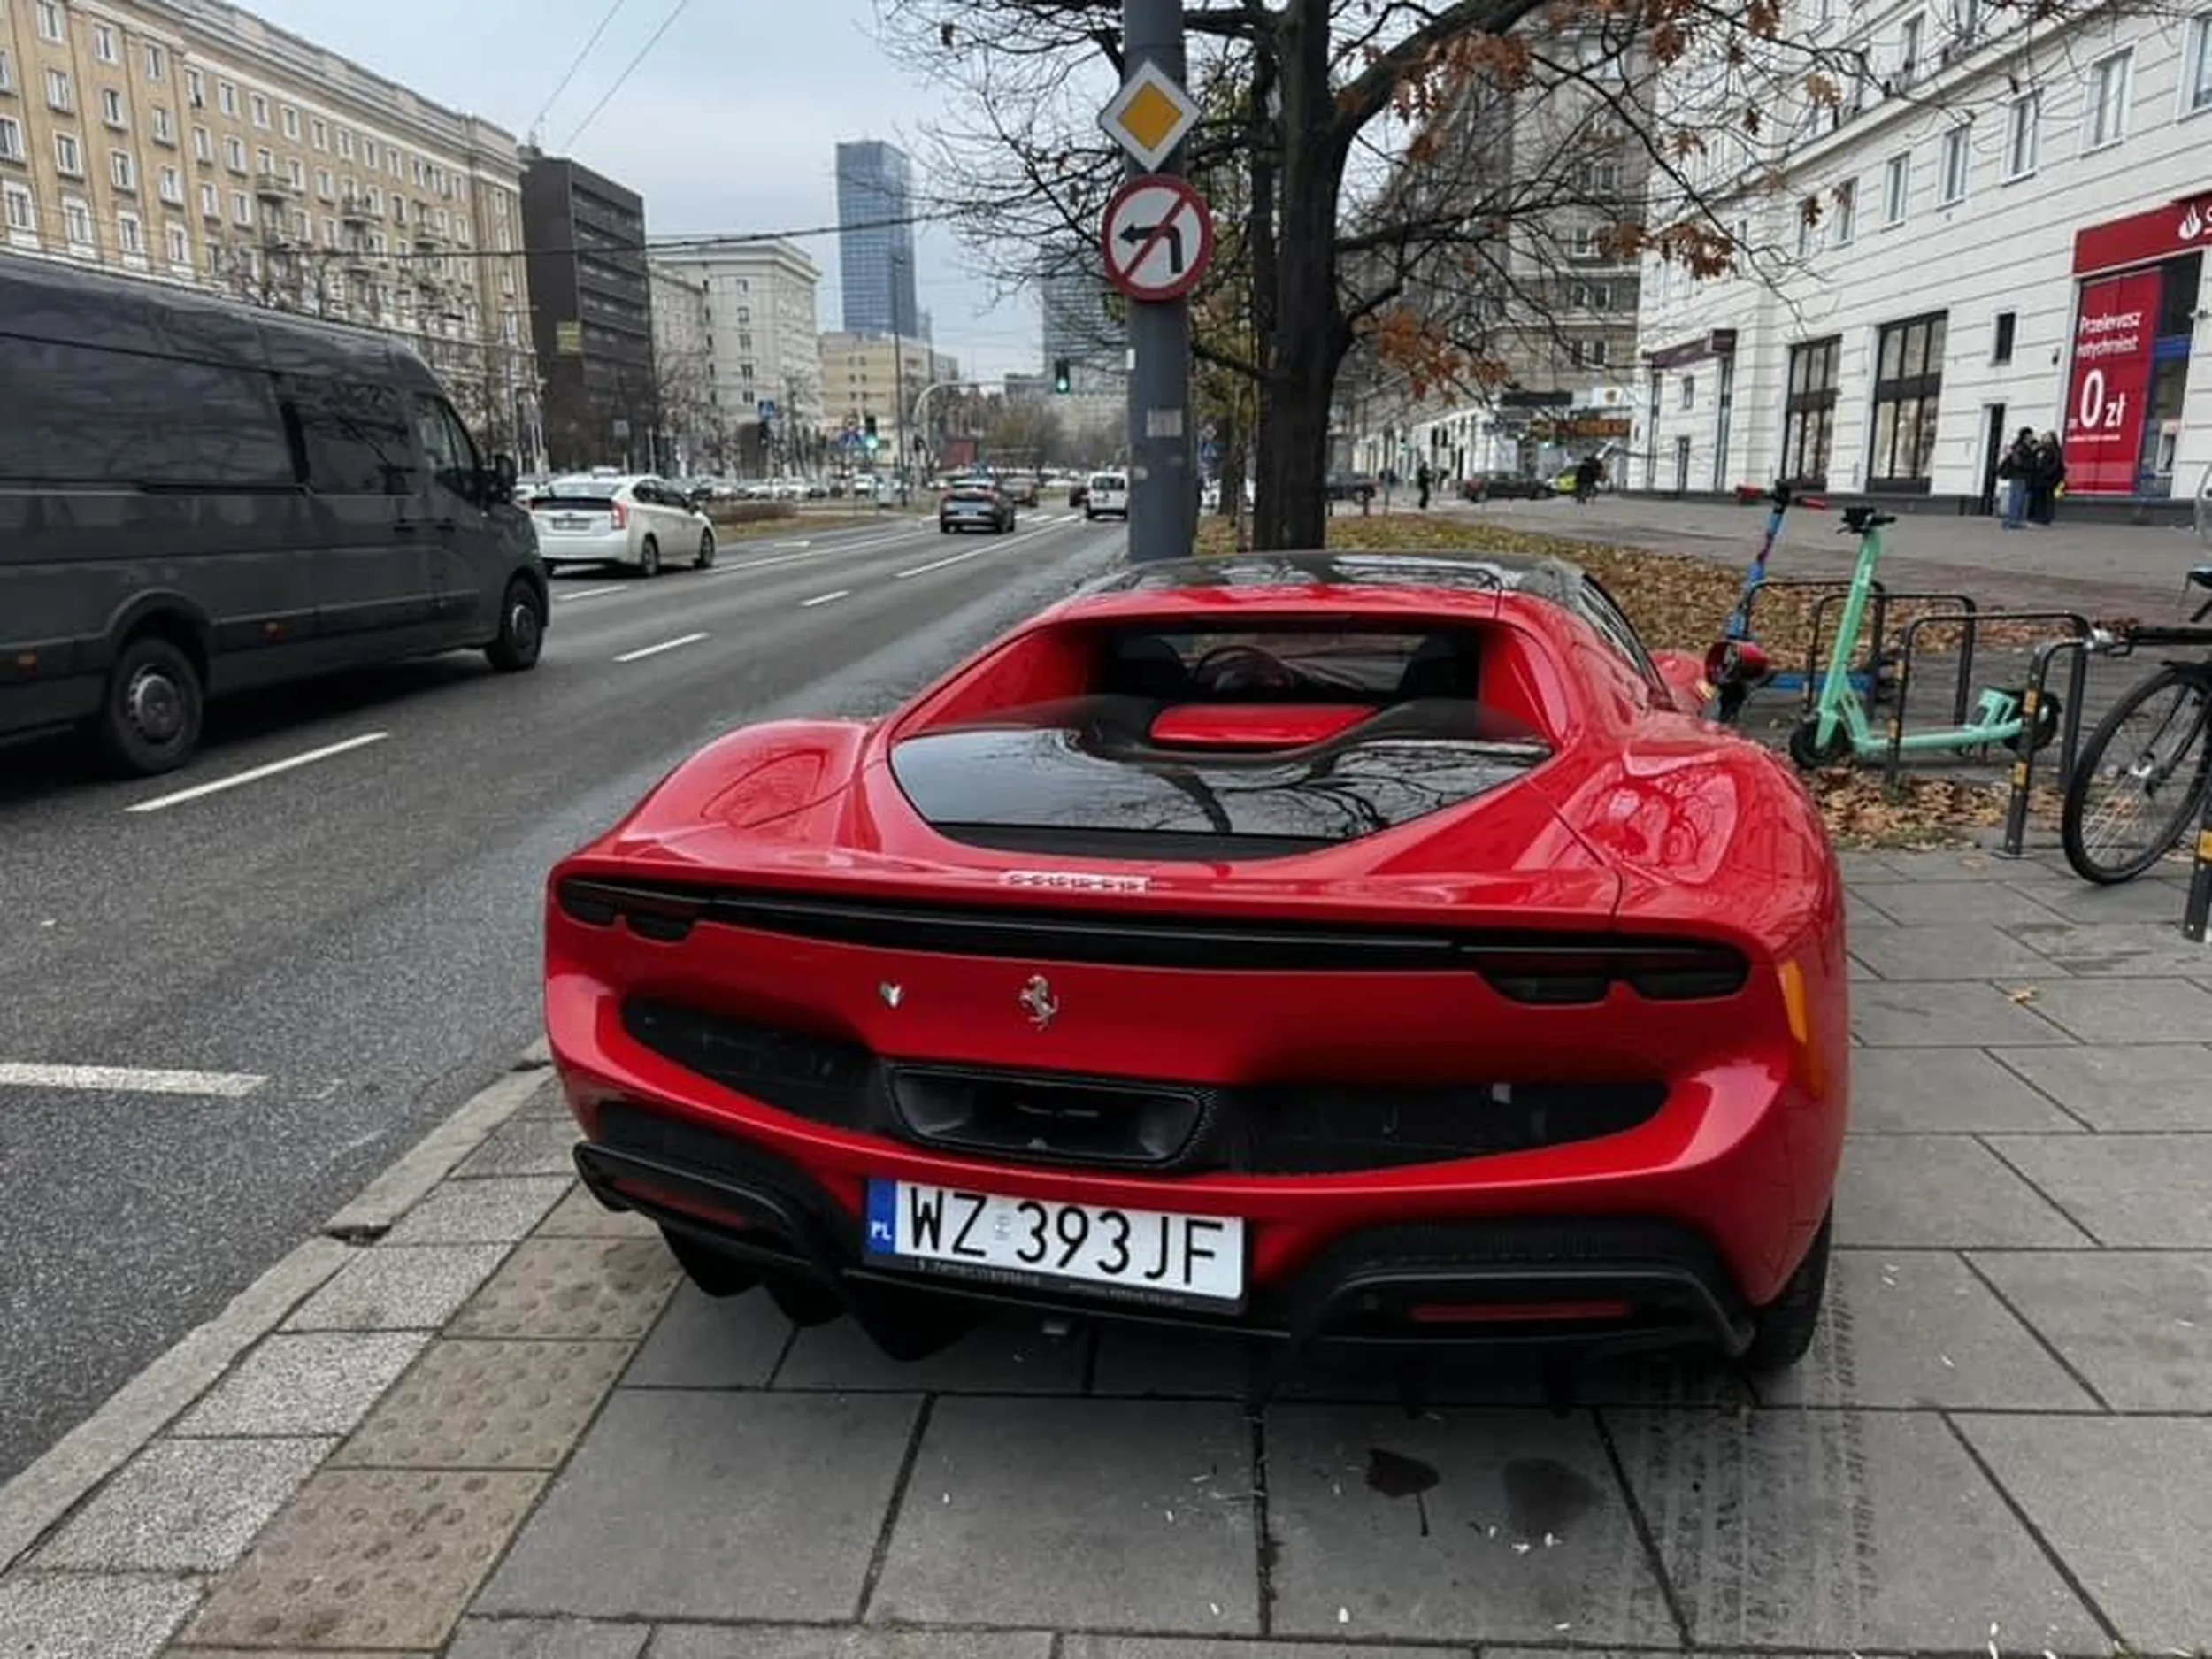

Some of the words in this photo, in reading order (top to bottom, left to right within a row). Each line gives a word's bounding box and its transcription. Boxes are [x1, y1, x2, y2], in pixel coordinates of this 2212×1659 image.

[2080, 368, 2104, 428] 0
[2104, 392, 2126, 428] zł
[871, 1220, 892, 1239] PL
[910, 1186, 987, 1257] WZ
[1015, 1200, 1225, 1285] 393JF
